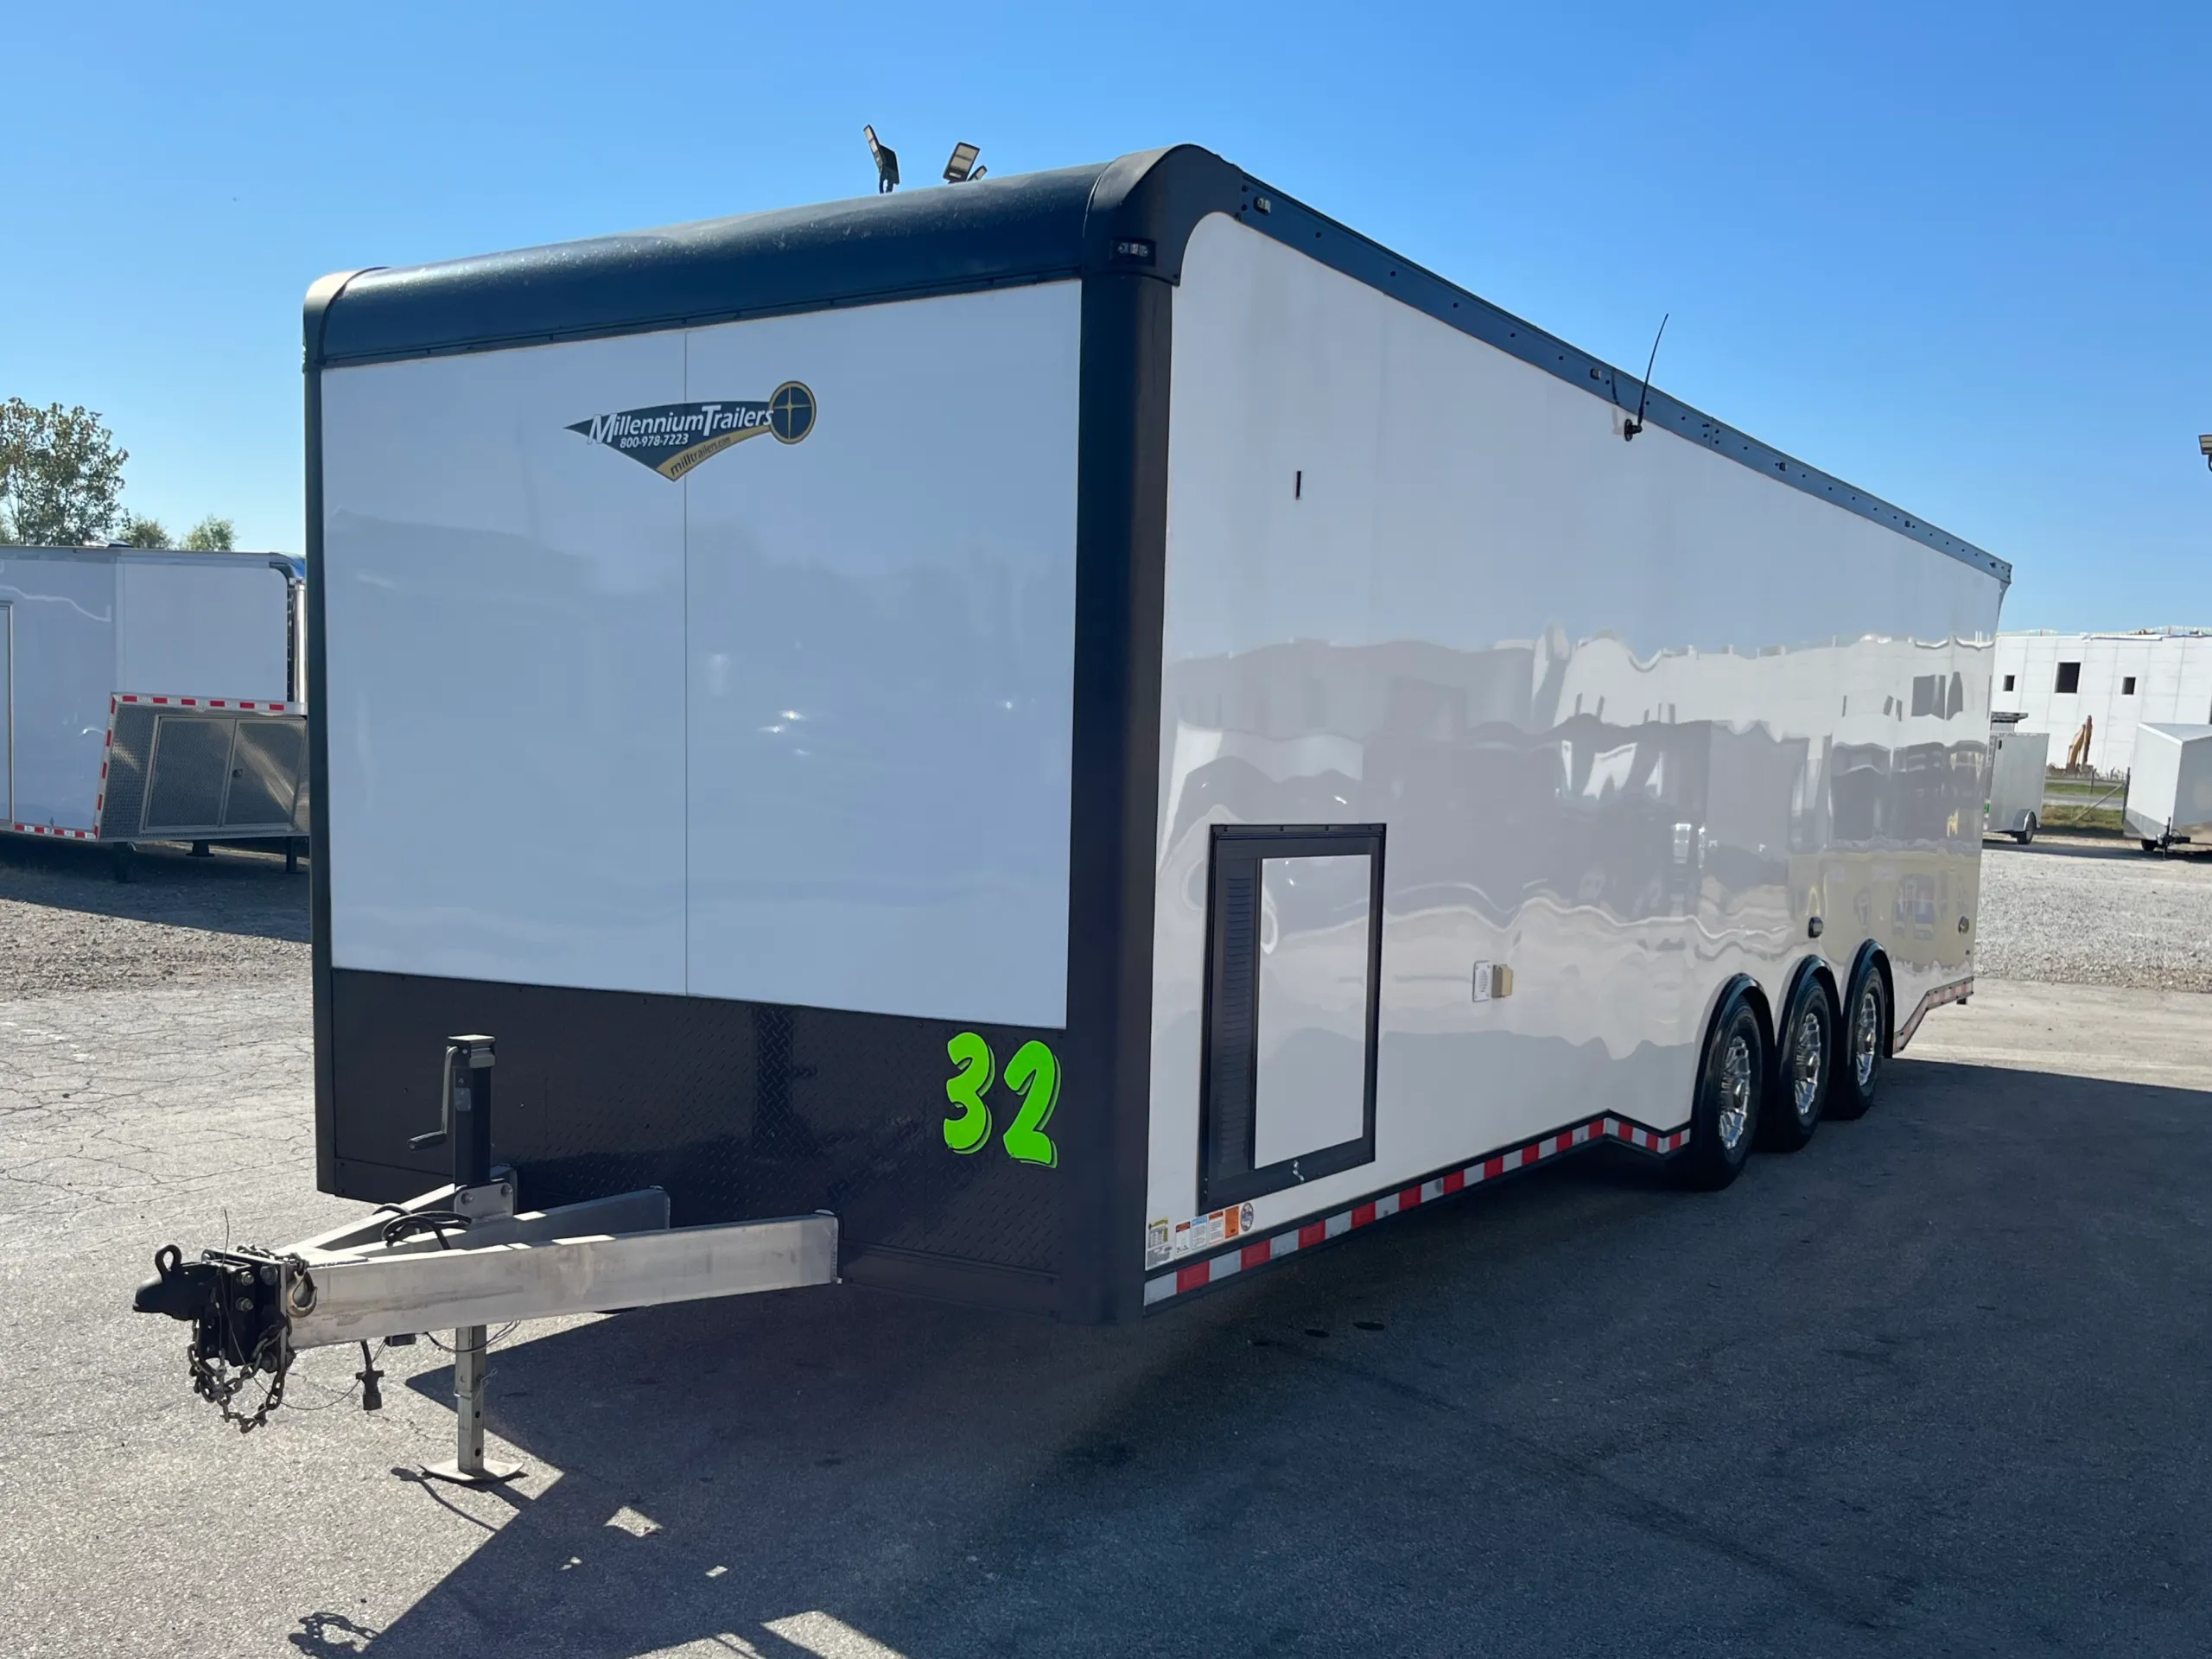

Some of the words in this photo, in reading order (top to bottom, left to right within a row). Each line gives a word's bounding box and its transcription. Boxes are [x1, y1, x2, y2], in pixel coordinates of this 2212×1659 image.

[619, 434, 690, 448] 800-978-7223
[670, 436, 732, 477] milltrailers.com
[943, 1031, 1063, 1169] 32
